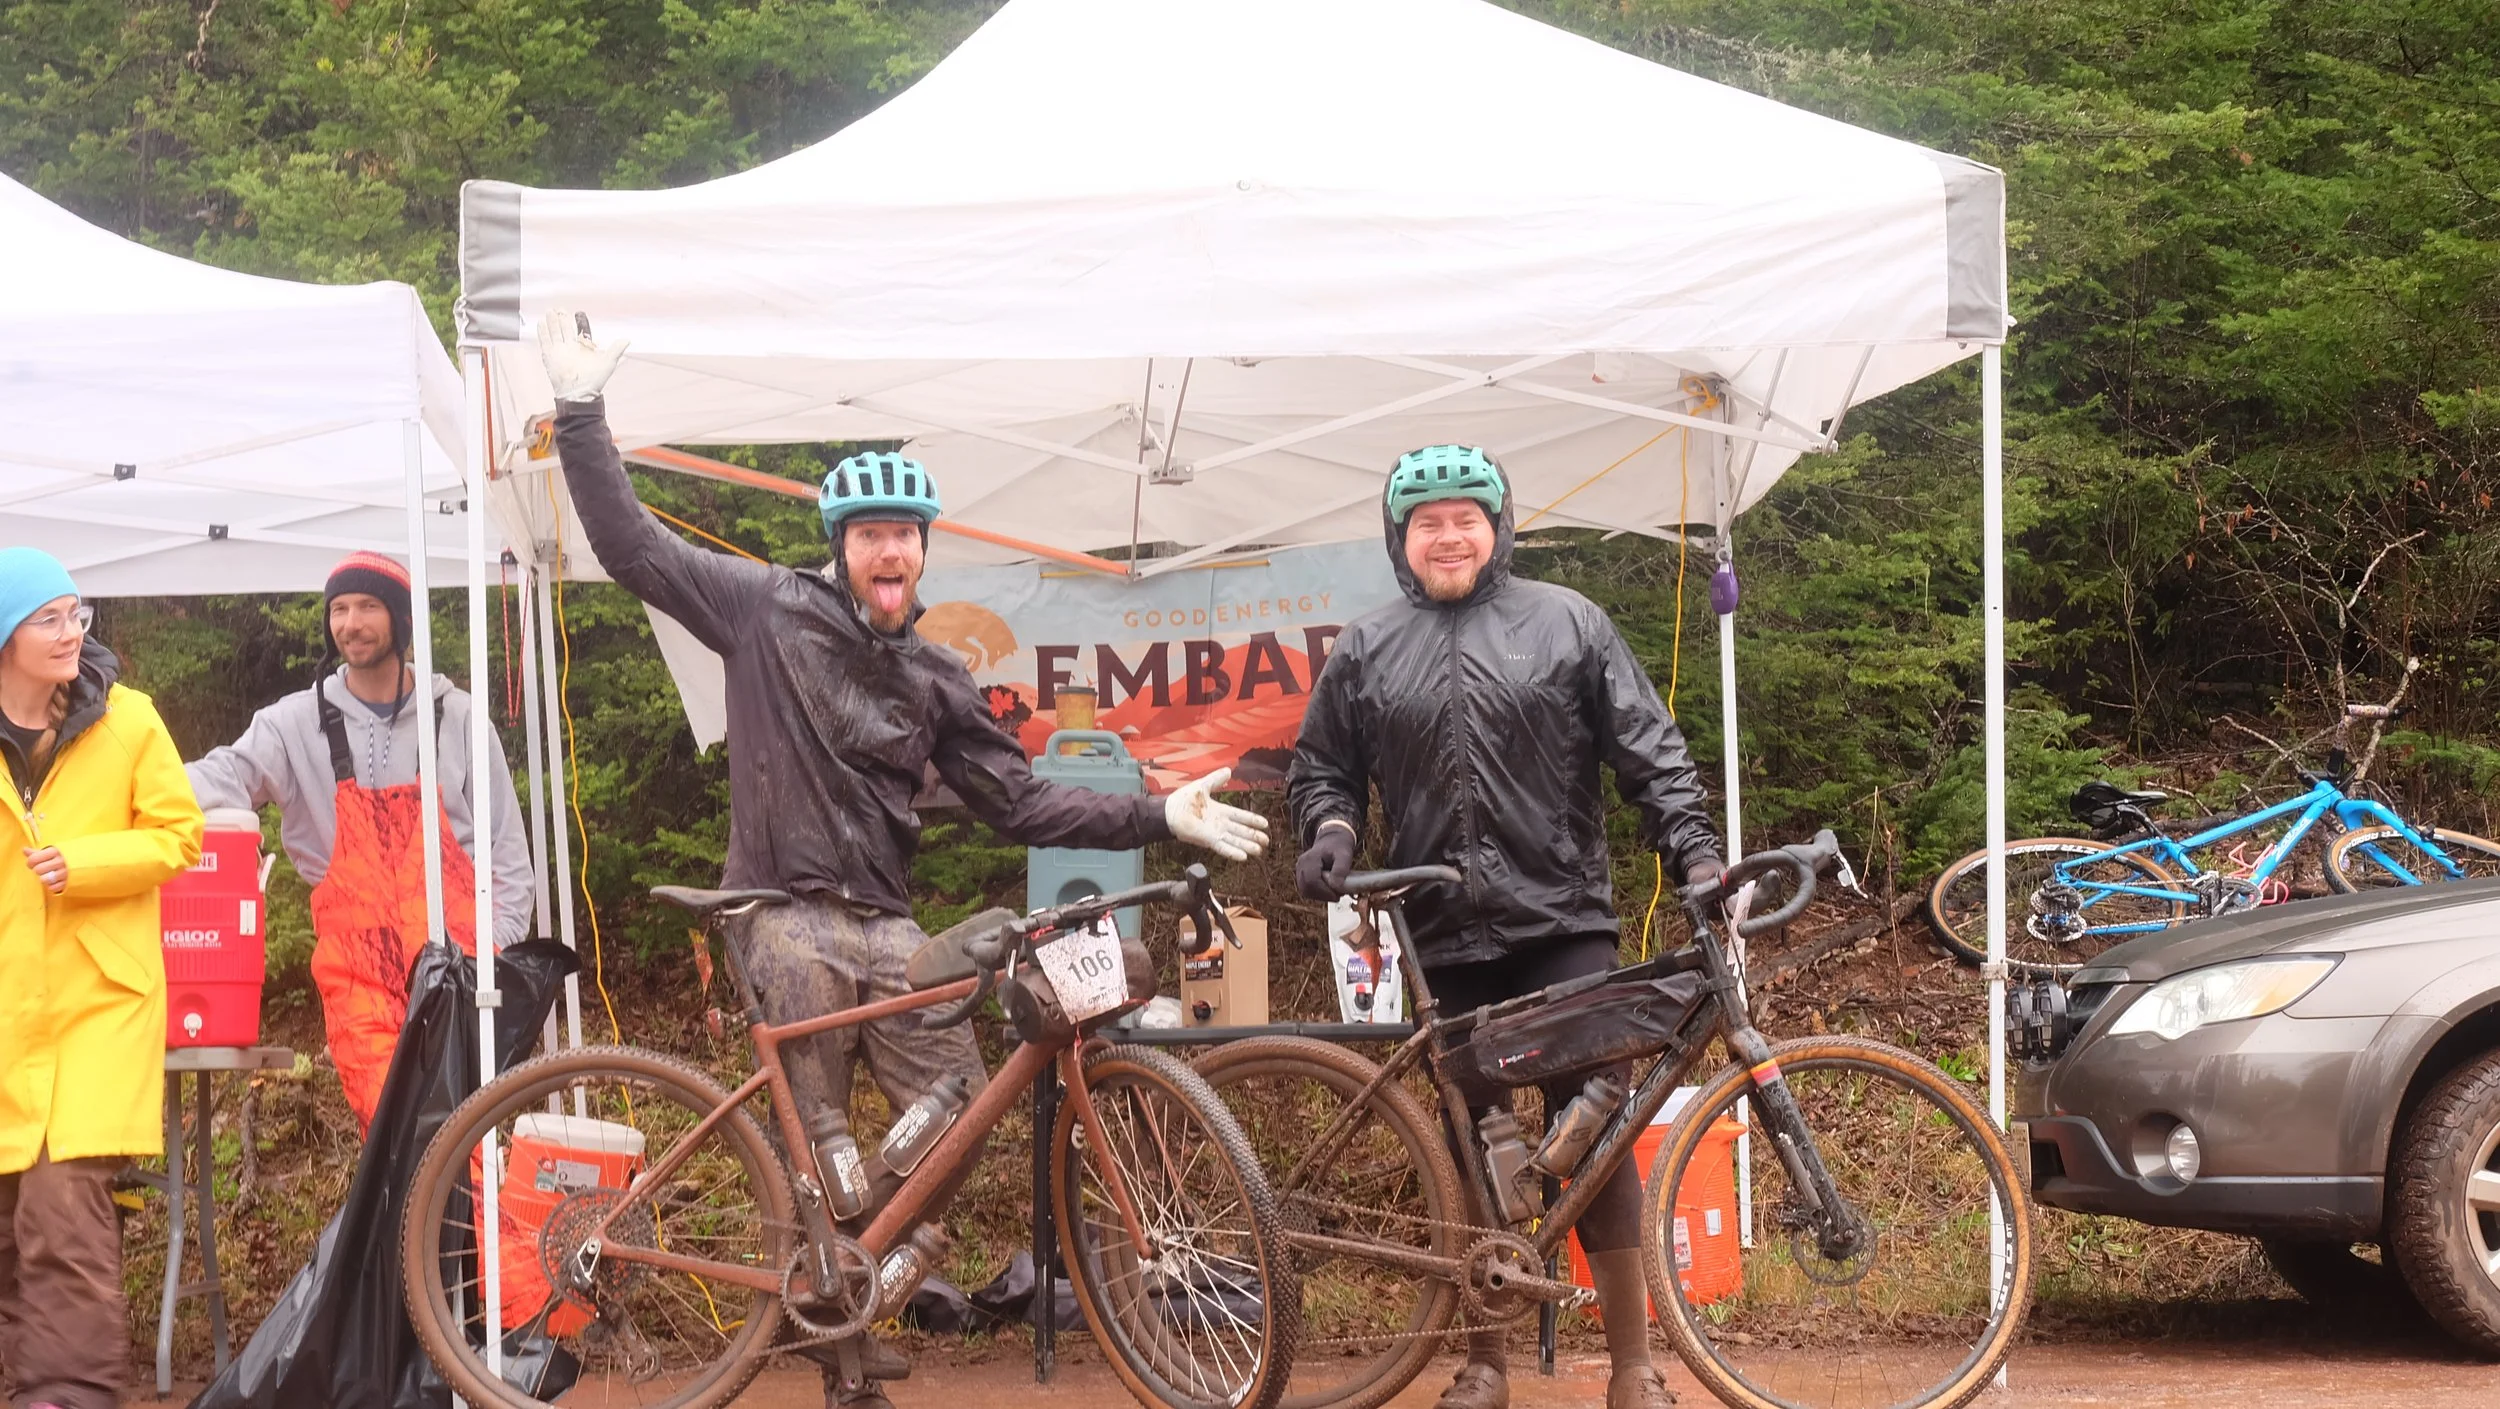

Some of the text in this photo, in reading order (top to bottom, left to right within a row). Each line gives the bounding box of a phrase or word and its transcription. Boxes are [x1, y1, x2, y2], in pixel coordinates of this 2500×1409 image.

[1034, 624, 1345, 711] EMBAR
[163, 930, 219, 943] IGLOO
[1067, 949, 1114, 983] 106
